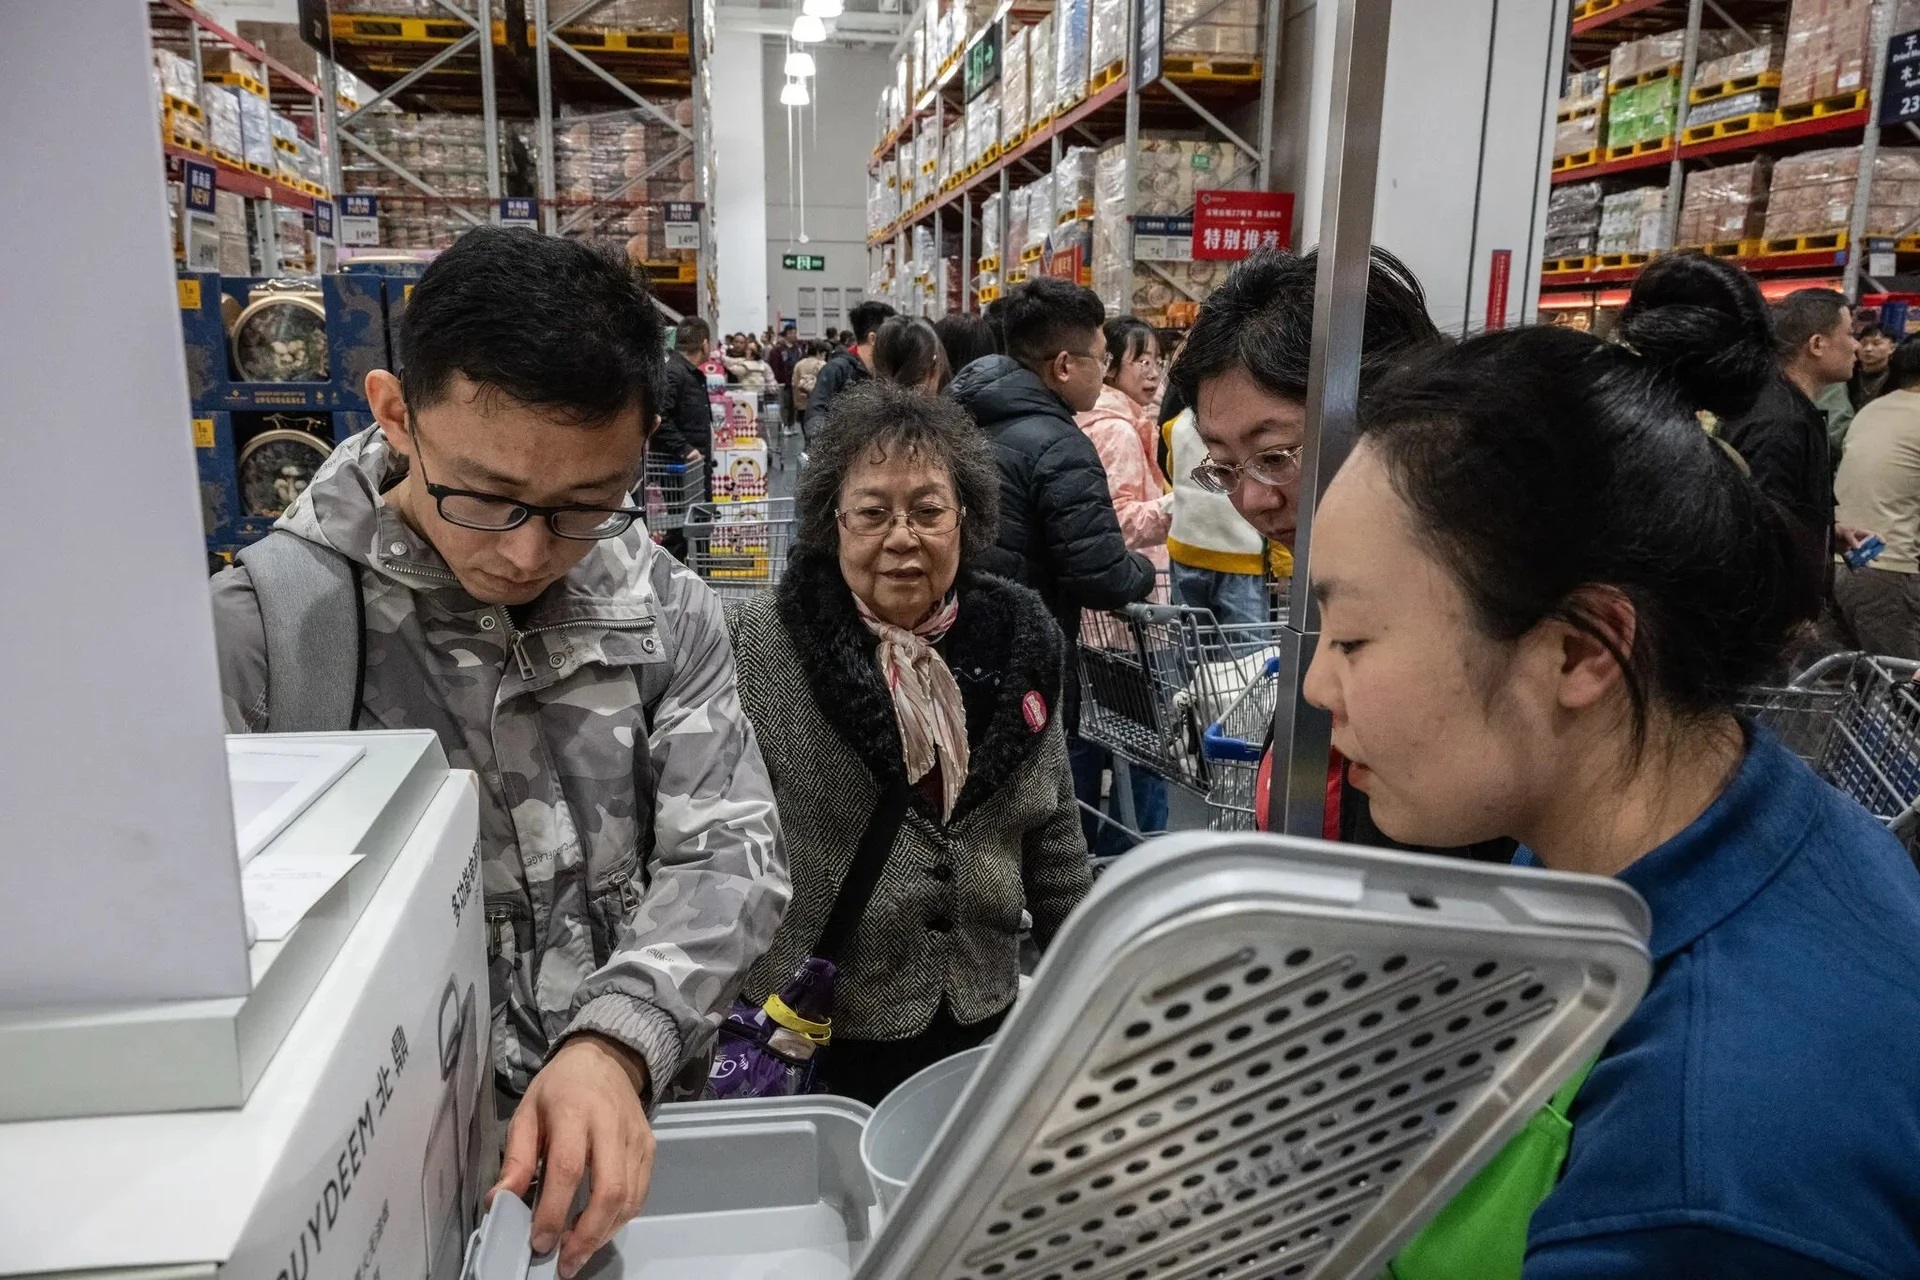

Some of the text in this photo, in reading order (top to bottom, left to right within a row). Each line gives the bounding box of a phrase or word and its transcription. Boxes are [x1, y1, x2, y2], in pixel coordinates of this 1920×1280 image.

[1900, 95, 1920, 115] 23
[1203, 227, 1281, 251] 特别推荐
[272, 1099, 375, 1280] UYDEEM
[375, 1024, 409, 1117] 北鼎
